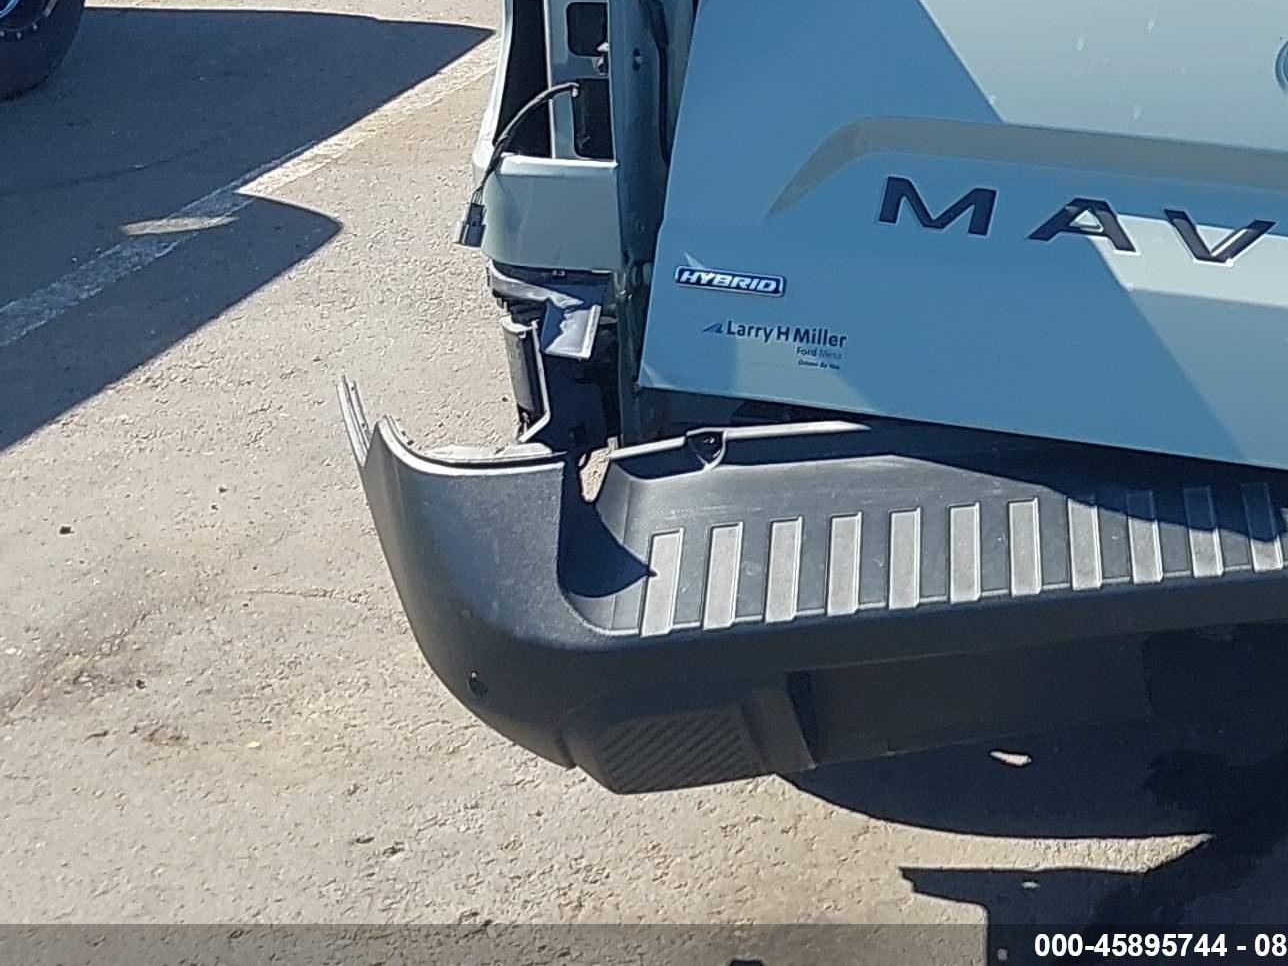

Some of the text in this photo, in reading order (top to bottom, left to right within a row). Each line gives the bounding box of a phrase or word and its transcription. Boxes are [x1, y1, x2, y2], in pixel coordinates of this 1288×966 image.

[679, 270, 777, 292] HYBRID
[727, 320, 848, 347] Larry H Miller
[796, 346, 817, 357] Ford
